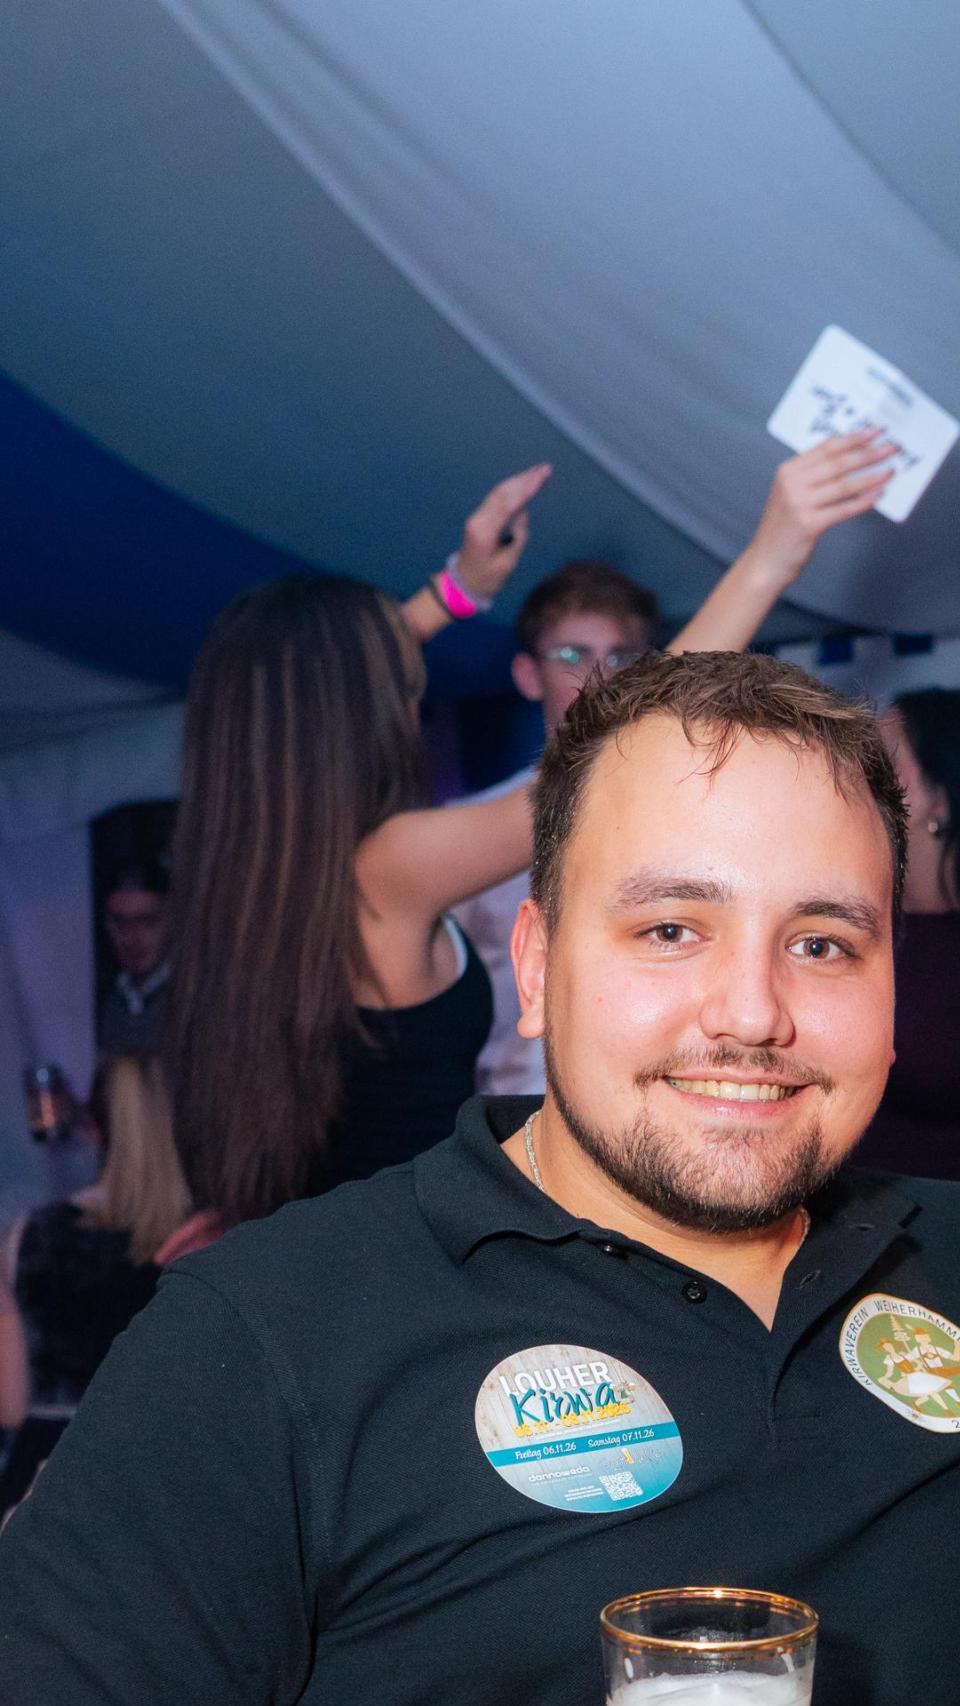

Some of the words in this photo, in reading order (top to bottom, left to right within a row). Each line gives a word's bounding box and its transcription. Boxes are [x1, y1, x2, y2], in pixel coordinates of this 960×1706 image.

[844, 1307, 872, 1386] KIRWAVEREIN
[499, 1362, 612, 1396] LOUHER
[509, 1382, 620, 1427] Kirwa
[514, 1448, 542, 1461] Freitag
[543, 1442, 577, 1455] 06.11.26
[588, 1435, 620, 1447] Samstag
[622, 1430, 655, 1442] 07.11.26
